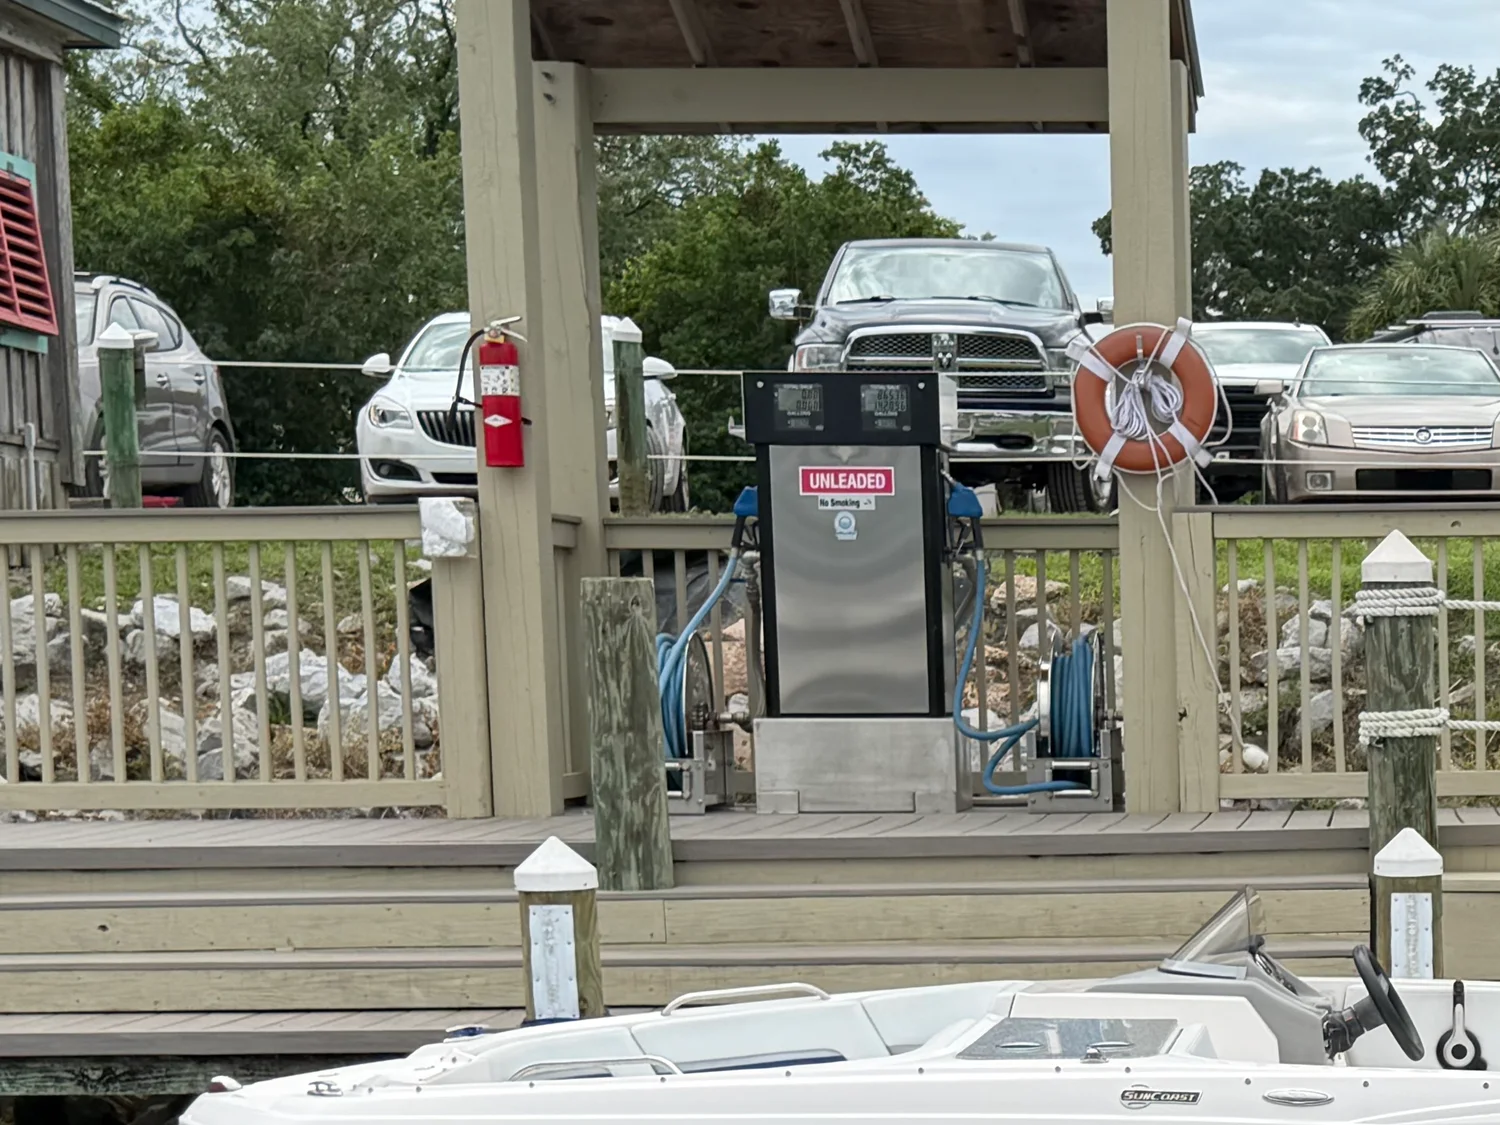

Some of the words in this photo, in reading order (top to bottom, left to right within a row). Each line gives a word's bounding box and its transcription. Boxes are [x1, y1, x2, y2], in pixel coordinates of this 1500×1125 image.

[809, 472, 886, 489] UNLEADED
[819, 498, 829, 507] No
[831, 498, 861, 509] Smoking
